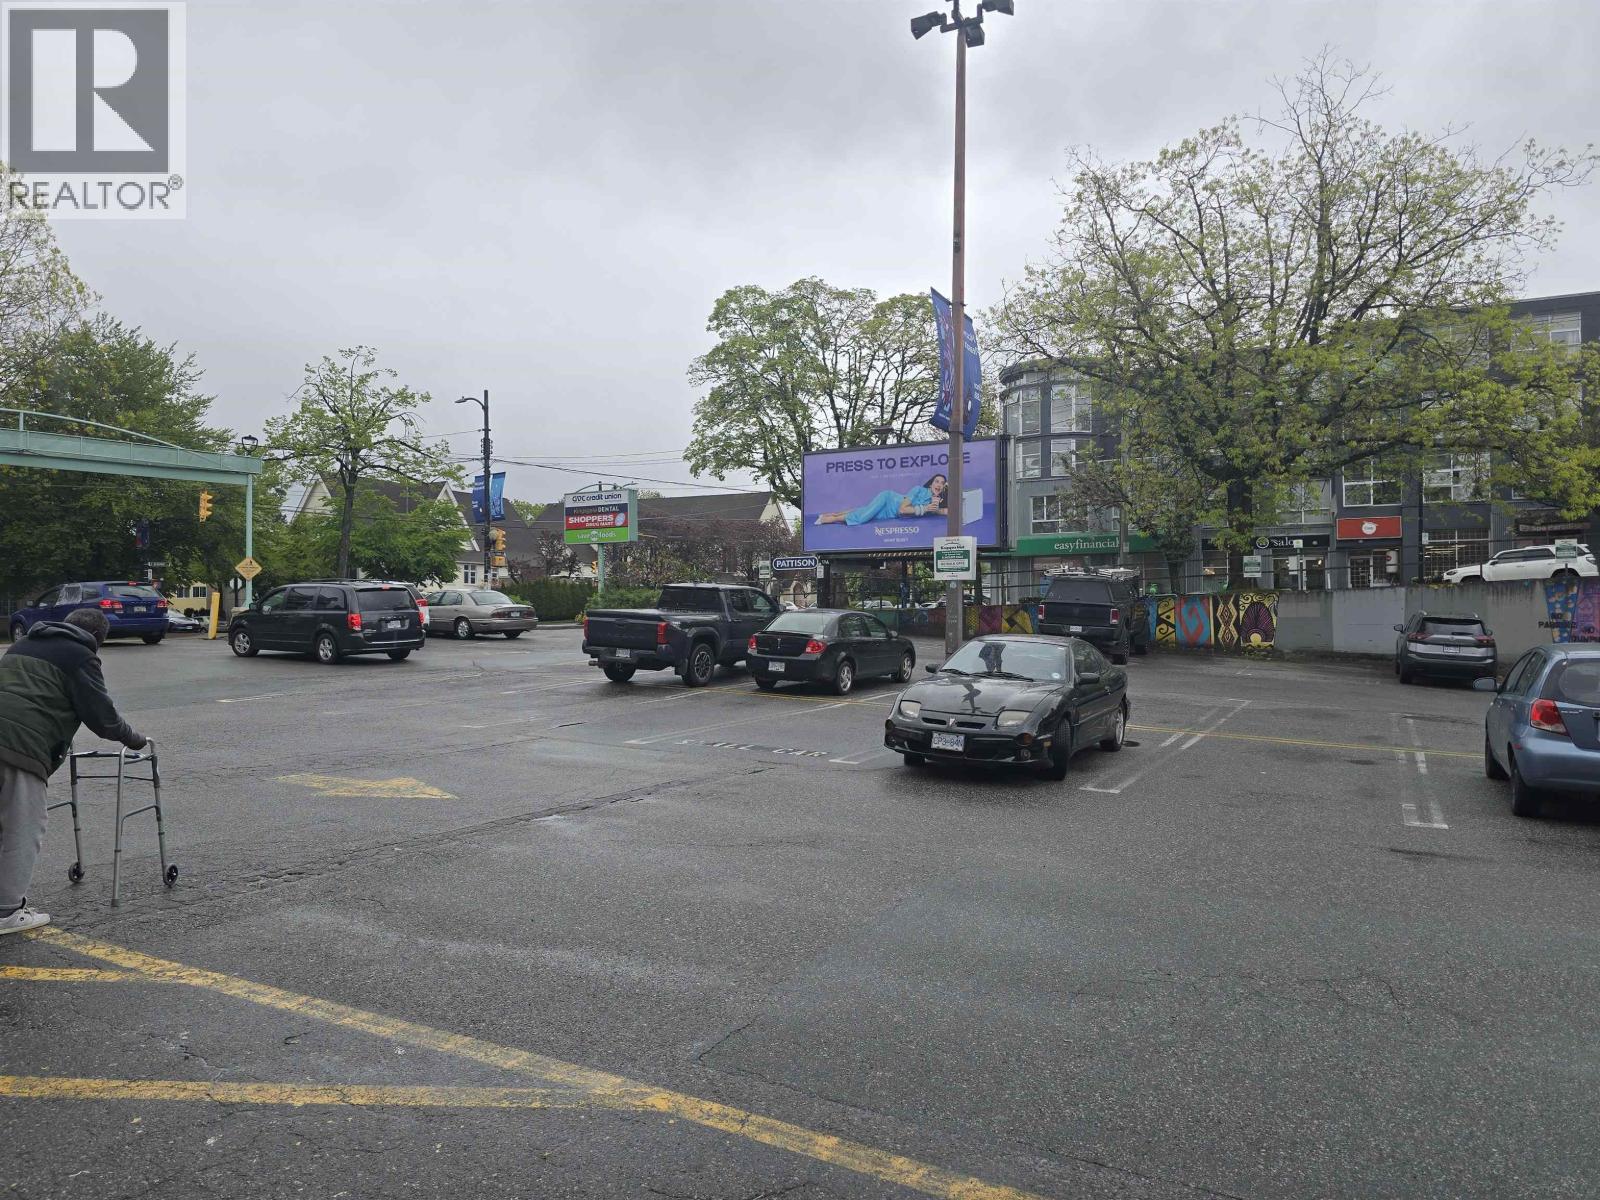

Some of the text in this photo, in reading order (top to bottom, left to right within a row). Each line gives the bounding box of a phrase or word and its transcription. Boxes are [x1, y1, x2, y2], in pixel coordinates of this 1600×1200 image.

[826, 451, 971, 474] PRESS TO EXPLOE
[586, 493, 604, 501] credit
[604, 492, 622, 500] union
[568, 514, 614, 524] SHOPPERS
[874, 526, 920, 536] NESPRESSO
[1053, 536, 1121, 552] easyfinancial
[1272, 537, 1295, 547] salo
[776, 558, 815, 568] PATTISON
